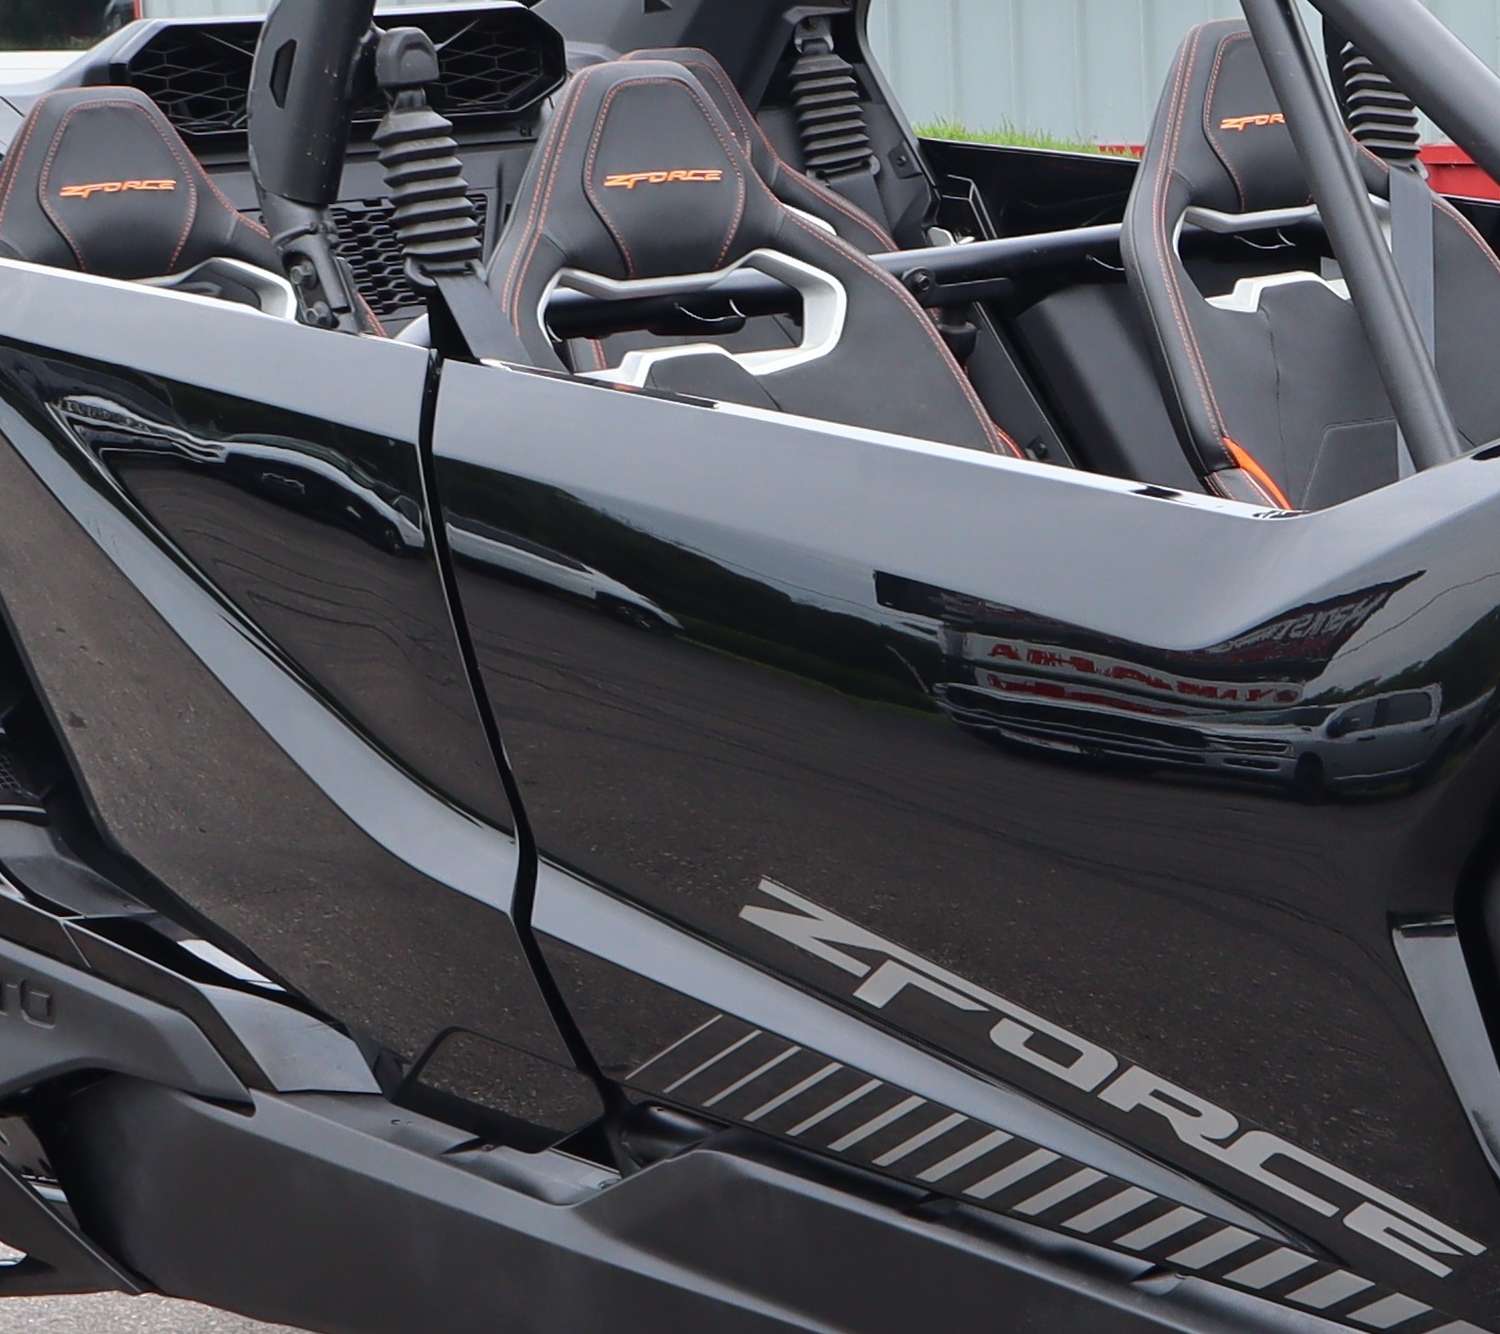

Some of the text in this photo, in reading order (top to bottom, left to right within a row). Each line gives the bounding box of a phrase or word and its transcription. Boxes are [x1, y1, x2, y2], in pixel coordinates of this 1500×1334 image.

[1220, 113, 1287, 132] ZFOR
[60, 178, 177, 199] ZFORCE
[603, 169, 724, 190] ZFORCE
[739, 875, 1488, 1277] ZFORCE
